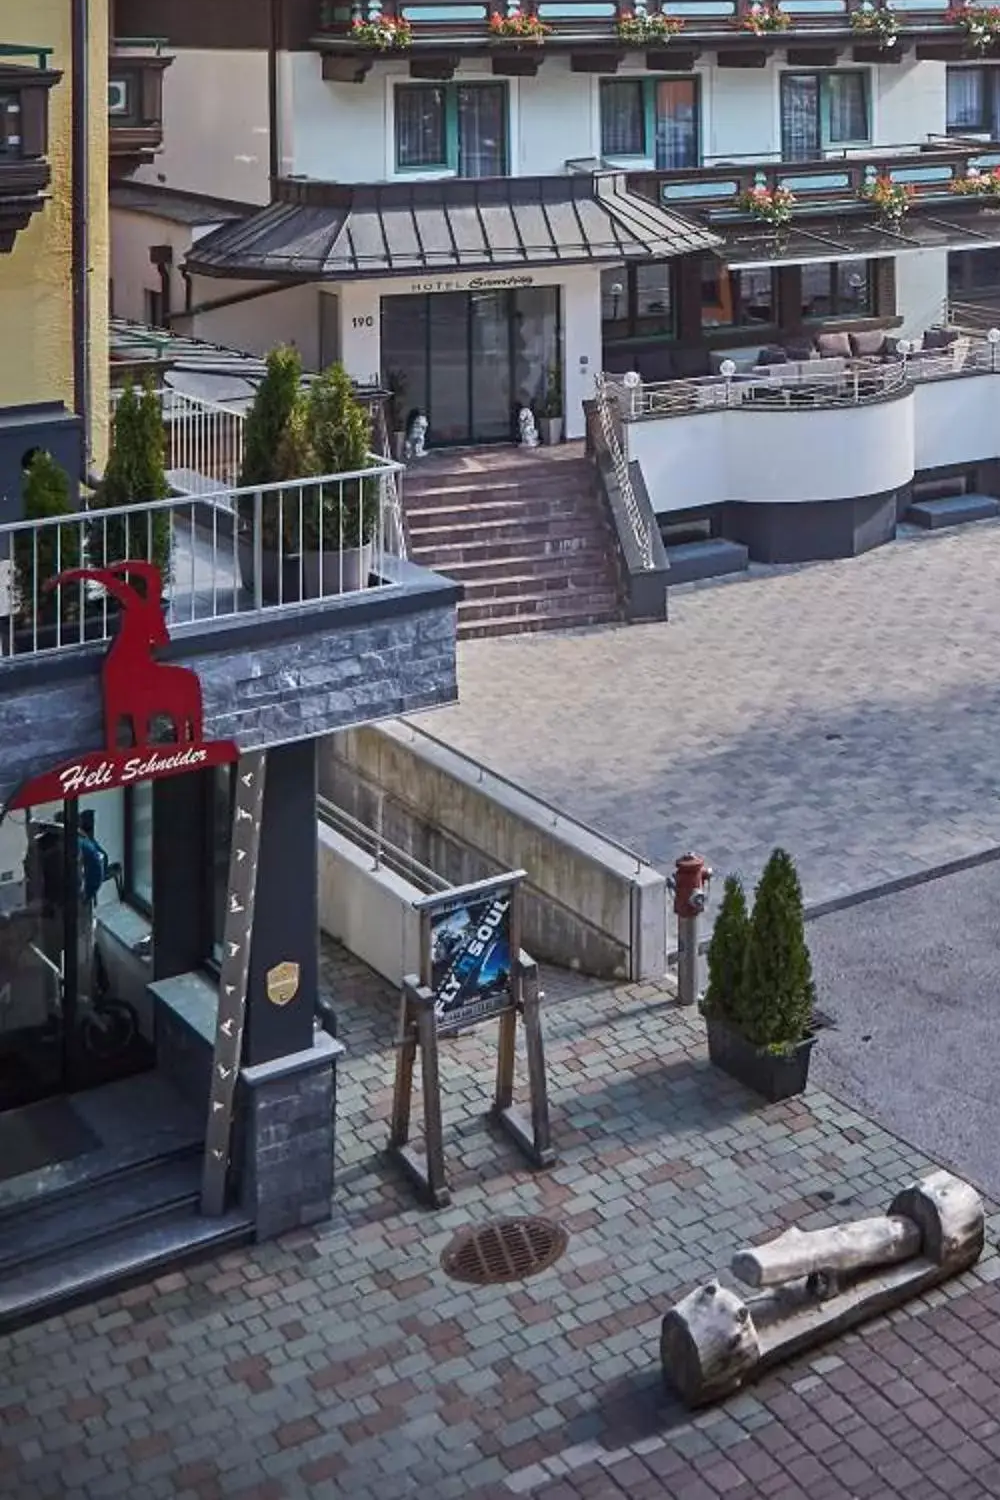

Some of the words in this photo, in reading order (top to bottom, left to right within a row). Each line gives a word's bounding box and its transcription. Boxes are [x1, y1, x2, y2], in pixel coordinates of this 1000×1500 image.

[411, 280, 465, 293] HOTEL
[351, 315, 375, 329] 190
[59, 762, 113, 794] Heli
[121, 747, 208, 782] Schneider
[433, 972, 462, 1018] FLY
[467, 900, 510, 957] SOUL
